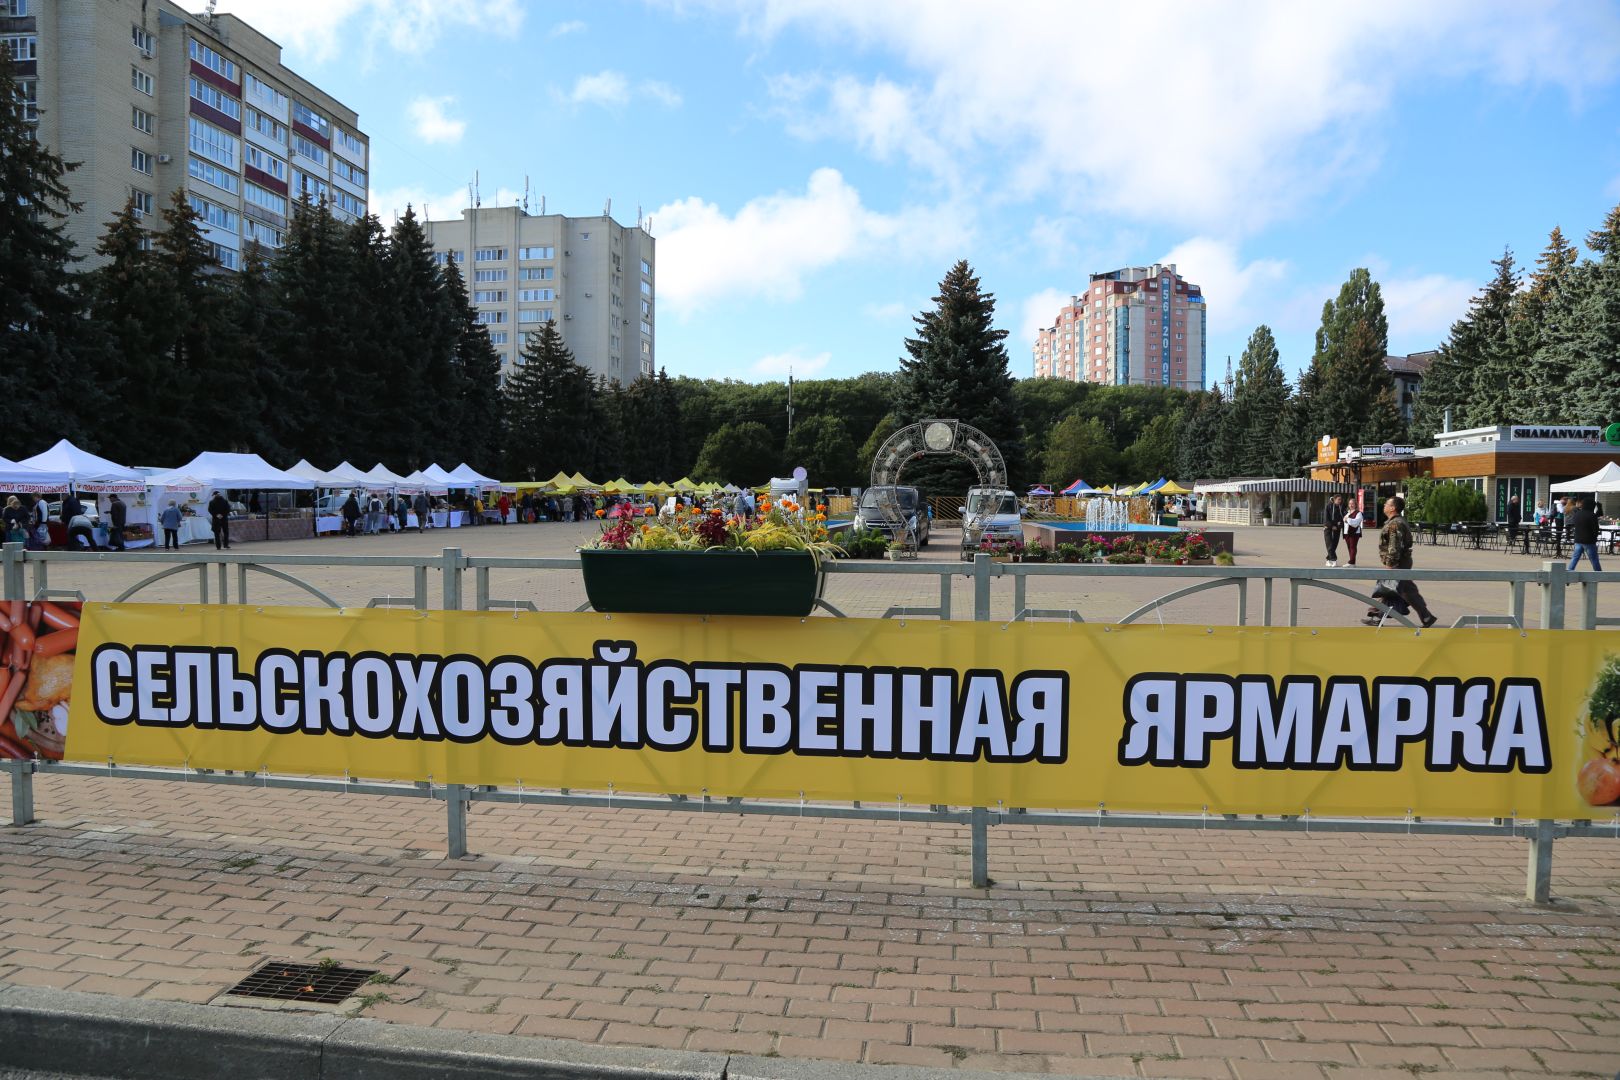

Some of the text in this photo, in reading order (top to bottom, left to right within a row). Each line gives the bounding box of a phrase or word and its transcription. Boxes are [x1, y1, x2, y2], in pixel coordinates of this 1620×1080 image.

[1513, 428, 1600, 439] SHAMANVAPE
[91, 640, 1553, 774] СЕЛЬСКОХОЗЯЙСТВЕННАЯ ЯРМАРКА
